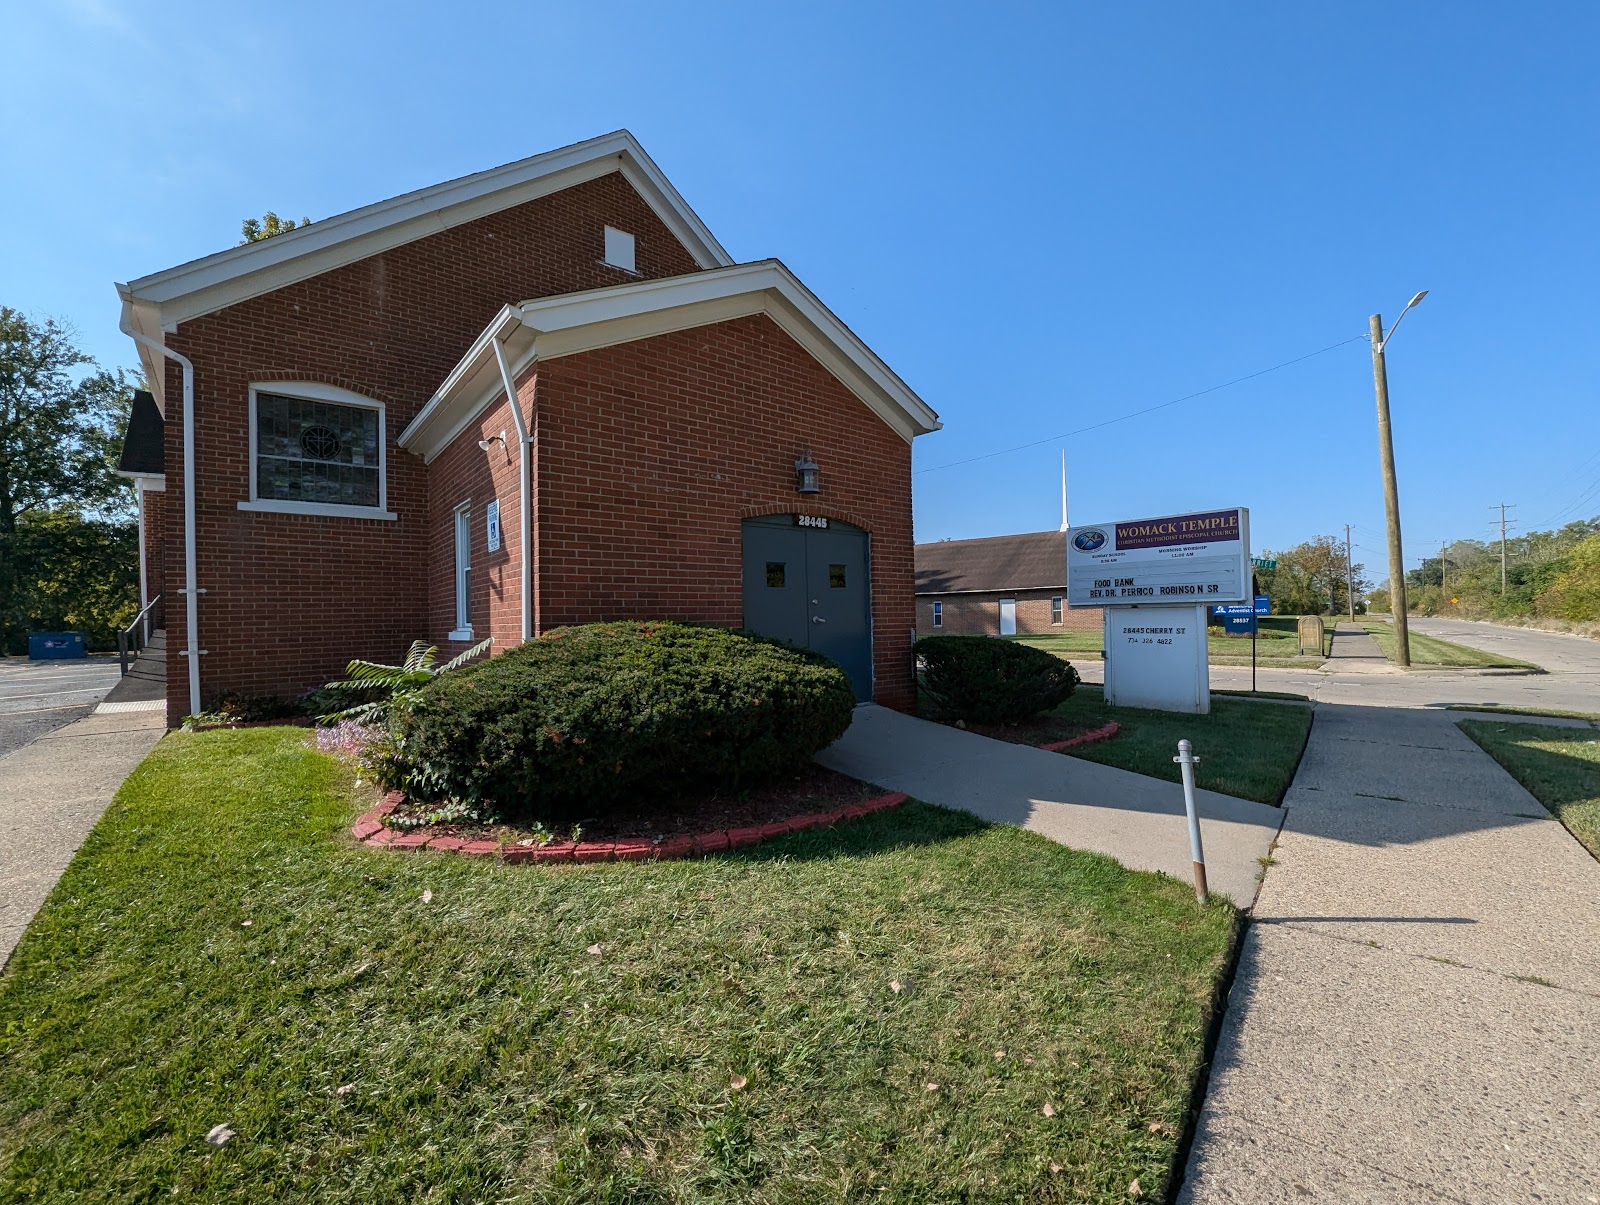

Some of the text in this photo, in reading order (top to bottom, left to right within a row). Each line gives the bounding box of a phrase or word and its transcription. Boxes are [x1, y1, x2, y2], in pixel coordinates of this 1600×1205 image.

[798, 515, 828, 529] 28445
[1118, 516, 1238, 538] WOMACK TEMPLE
[1146, 535, 1178, 543] METHODIST
[1179, 532, 1210, 540] EPISCOPAL
[1252, 559, 1273, 568] RRIET
[1094, 578, 1134, 588] FOOD BANK
[1121, 587, 1154, 596] PERRICO
[1207, 584, 1219, 593] SR
[1176, 627, 1186, 635] ST
